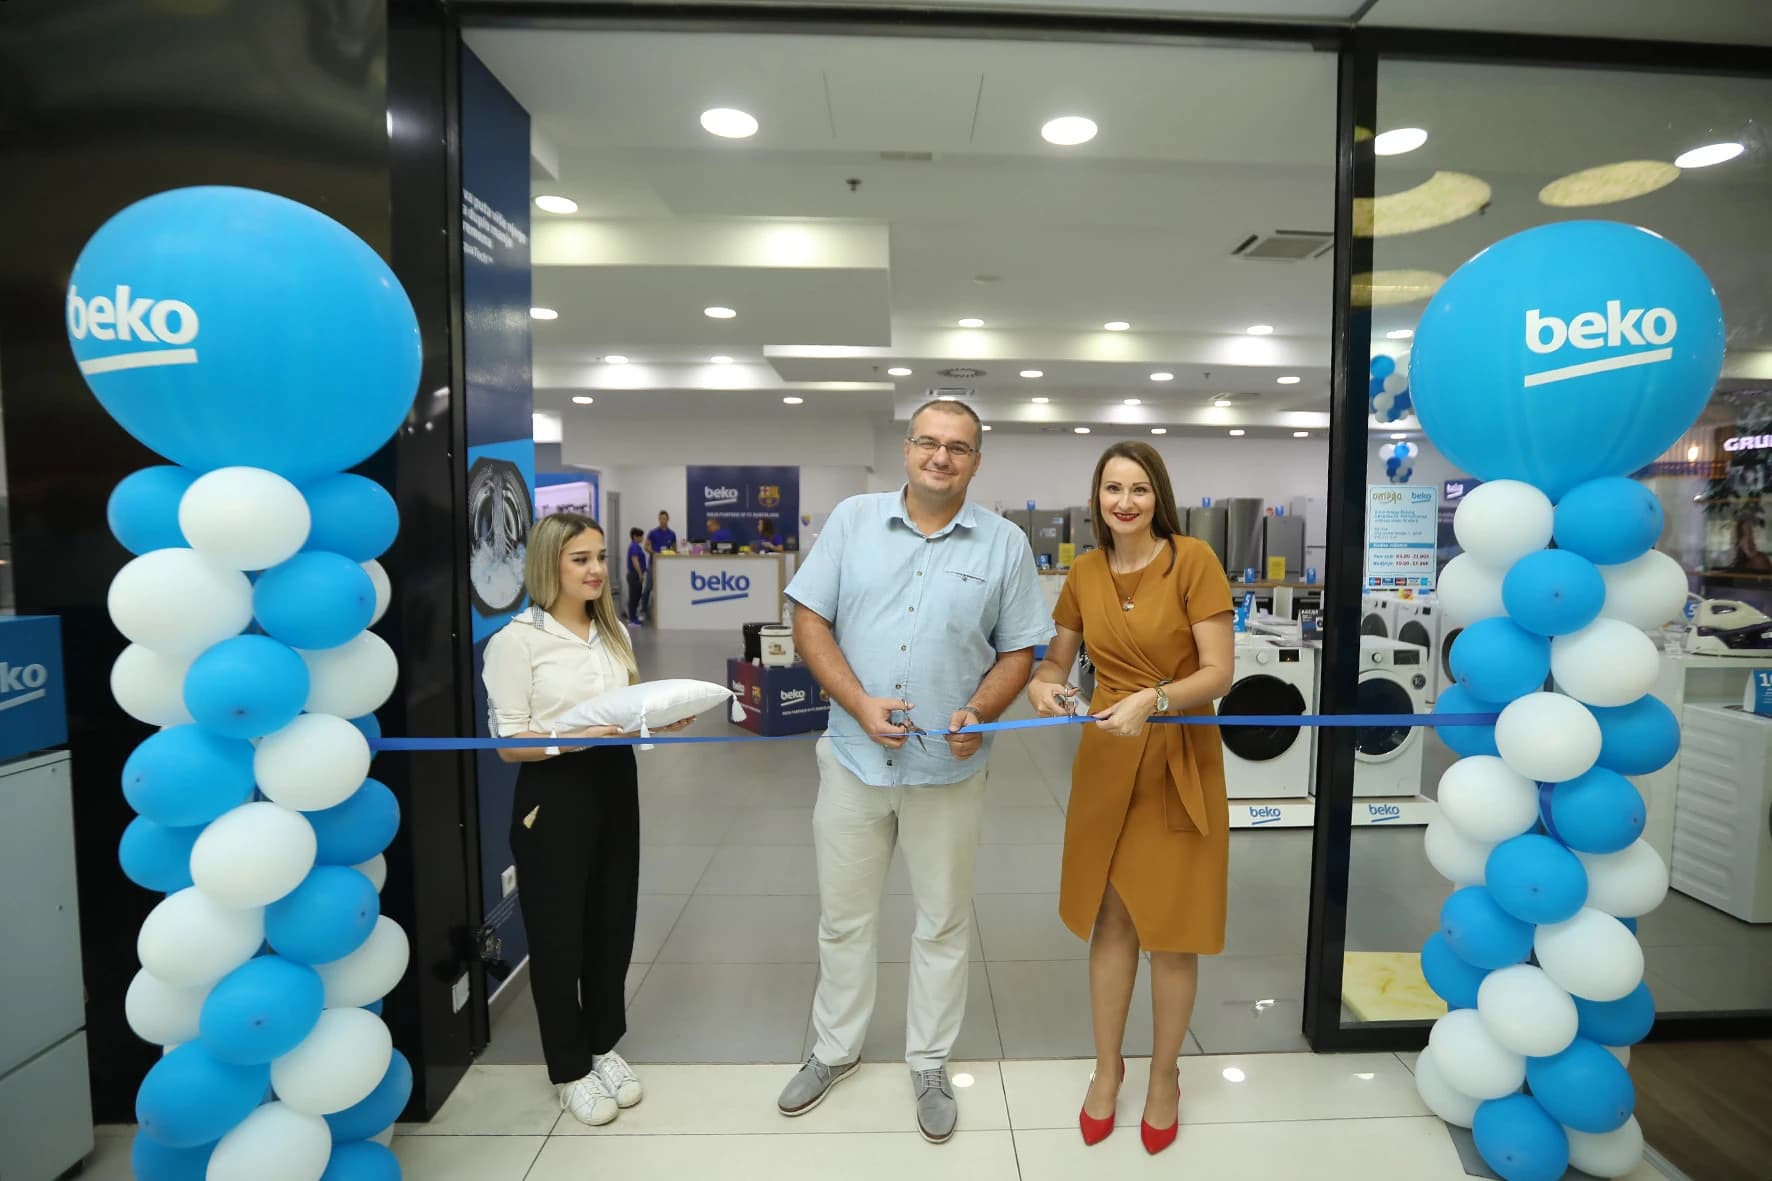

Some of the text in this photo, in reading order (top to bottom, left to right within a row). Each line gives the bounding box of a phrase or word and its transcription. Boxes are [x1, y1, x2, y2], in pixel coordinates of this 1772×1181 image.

[66, 284, 199, 345] beko
[1525, 300, 1677, 354] beko
[704, 486, 738, 499] beko
[690, 570, 750, 591] beko
[780, 688, 805, 701] beko
[1250, 806, 1281, 818] beko
[1368, 804, 1400, 816] beko
